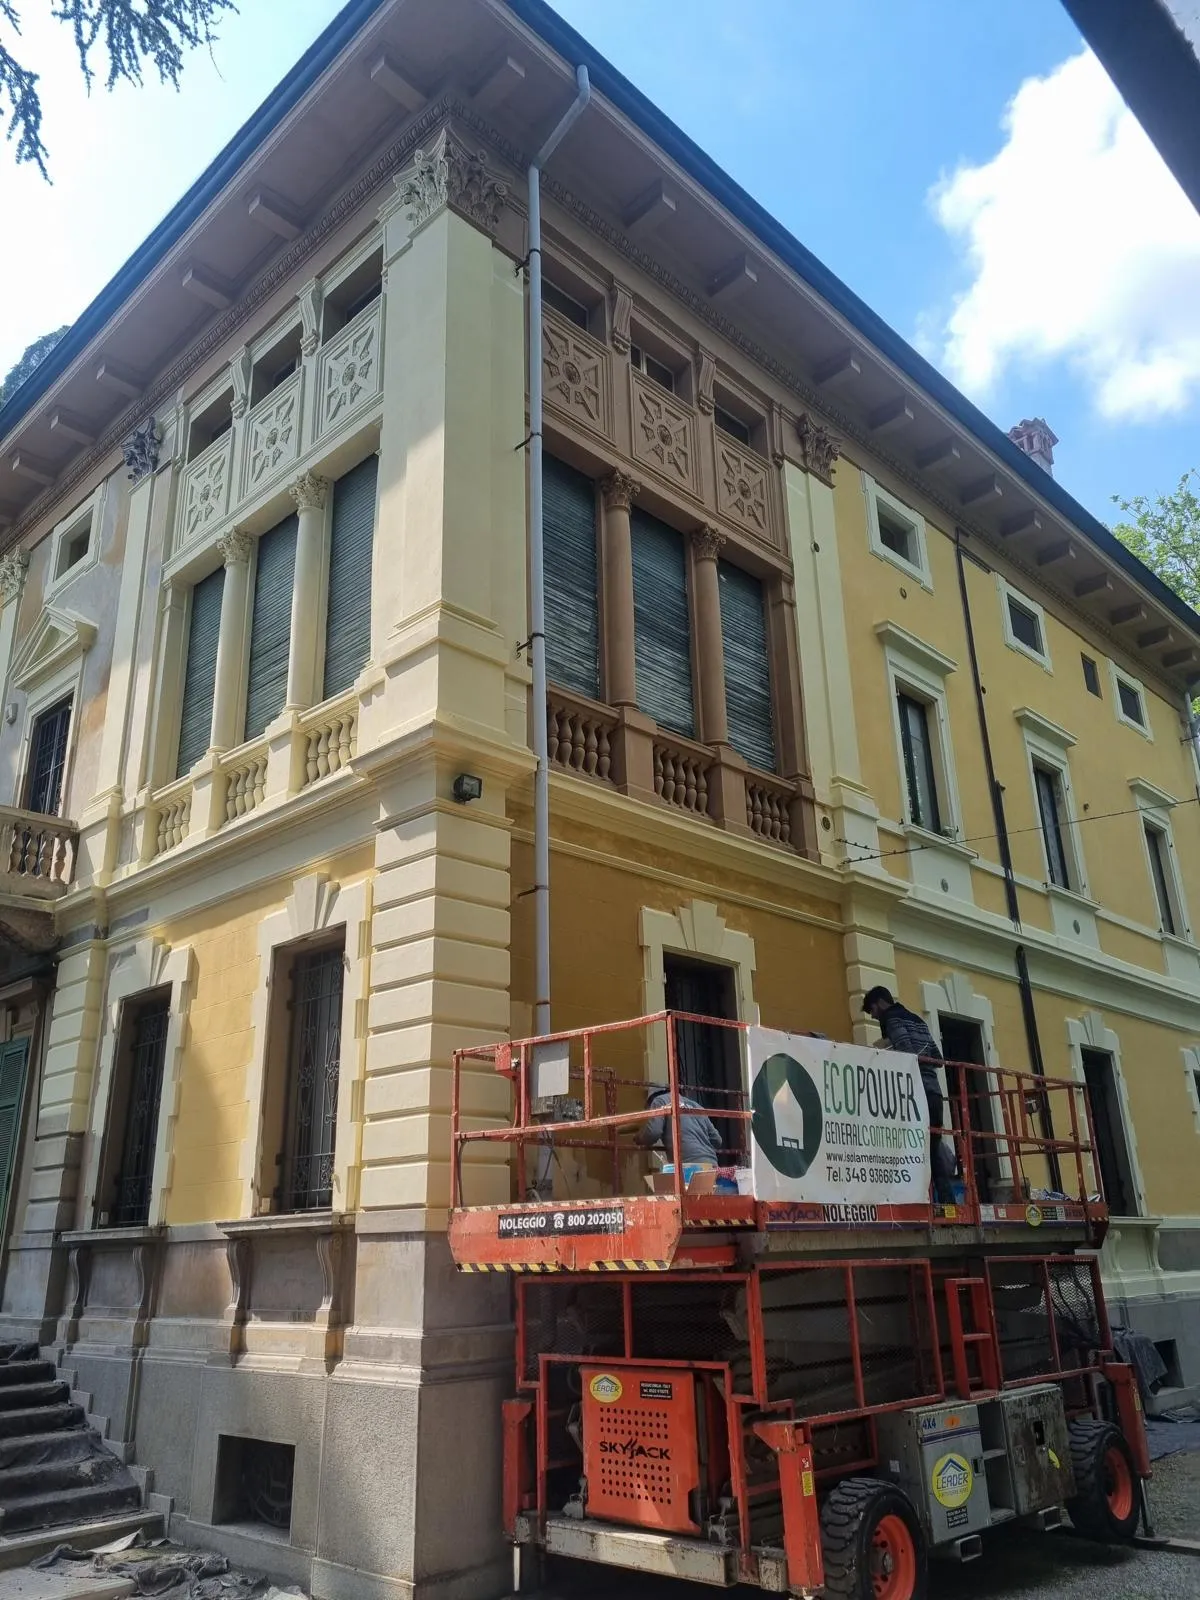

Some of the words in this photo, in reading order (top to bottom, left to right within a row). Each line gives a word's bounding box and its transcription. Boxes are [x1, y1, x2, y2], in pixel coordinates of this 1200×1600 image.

[823, 1060, 921, 1121] ECOPOWER
[826, 1151, 926, 1167] www.isolamentoacappotto.i
[826, 1166, 843, 1182] Tel.
[845, 1168, 867, 1183] 348
[499, 1216, 546, 1230] NOLEGGIO
[567, 1214, 586, 1226] 800
[587, 1212, 623, 1226] 202050
[823, 1204, 878, 1222] NOLEGGIO
[599, 1438, 671, 1460] SKYJACK
[936, 1472, 969, 1490] LEADER
